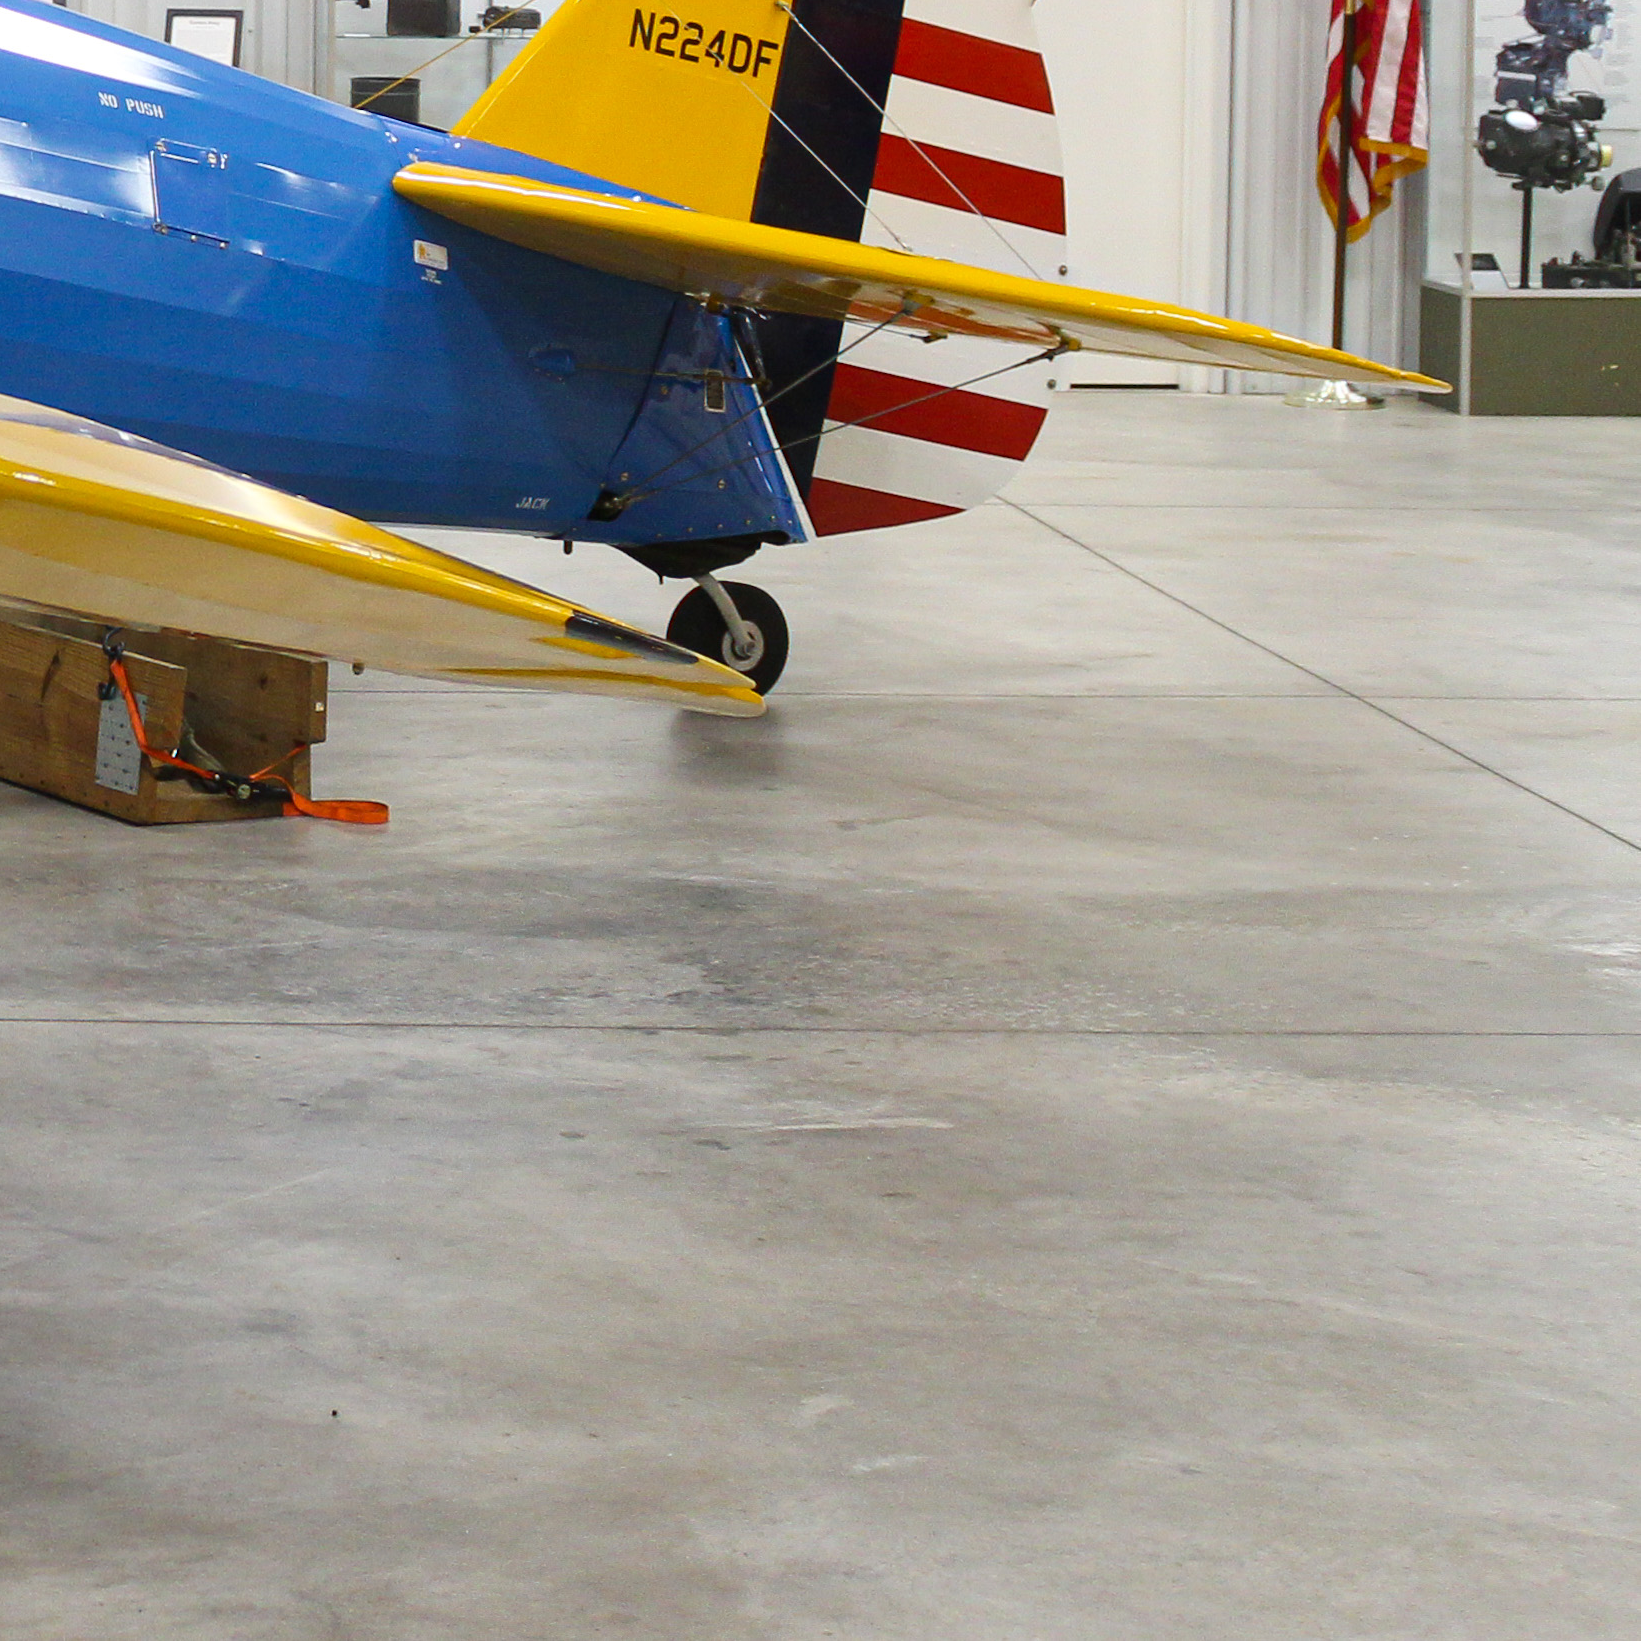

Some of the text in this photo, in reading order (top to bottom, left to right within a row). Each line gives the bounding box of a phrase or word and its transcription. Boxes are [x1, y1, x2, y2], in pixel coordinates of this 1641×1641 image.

[629, 8, 779, 78] N224DF
[98, 92, 163, 119] NO PUSH
[516, 496, 551, 510] JACK
